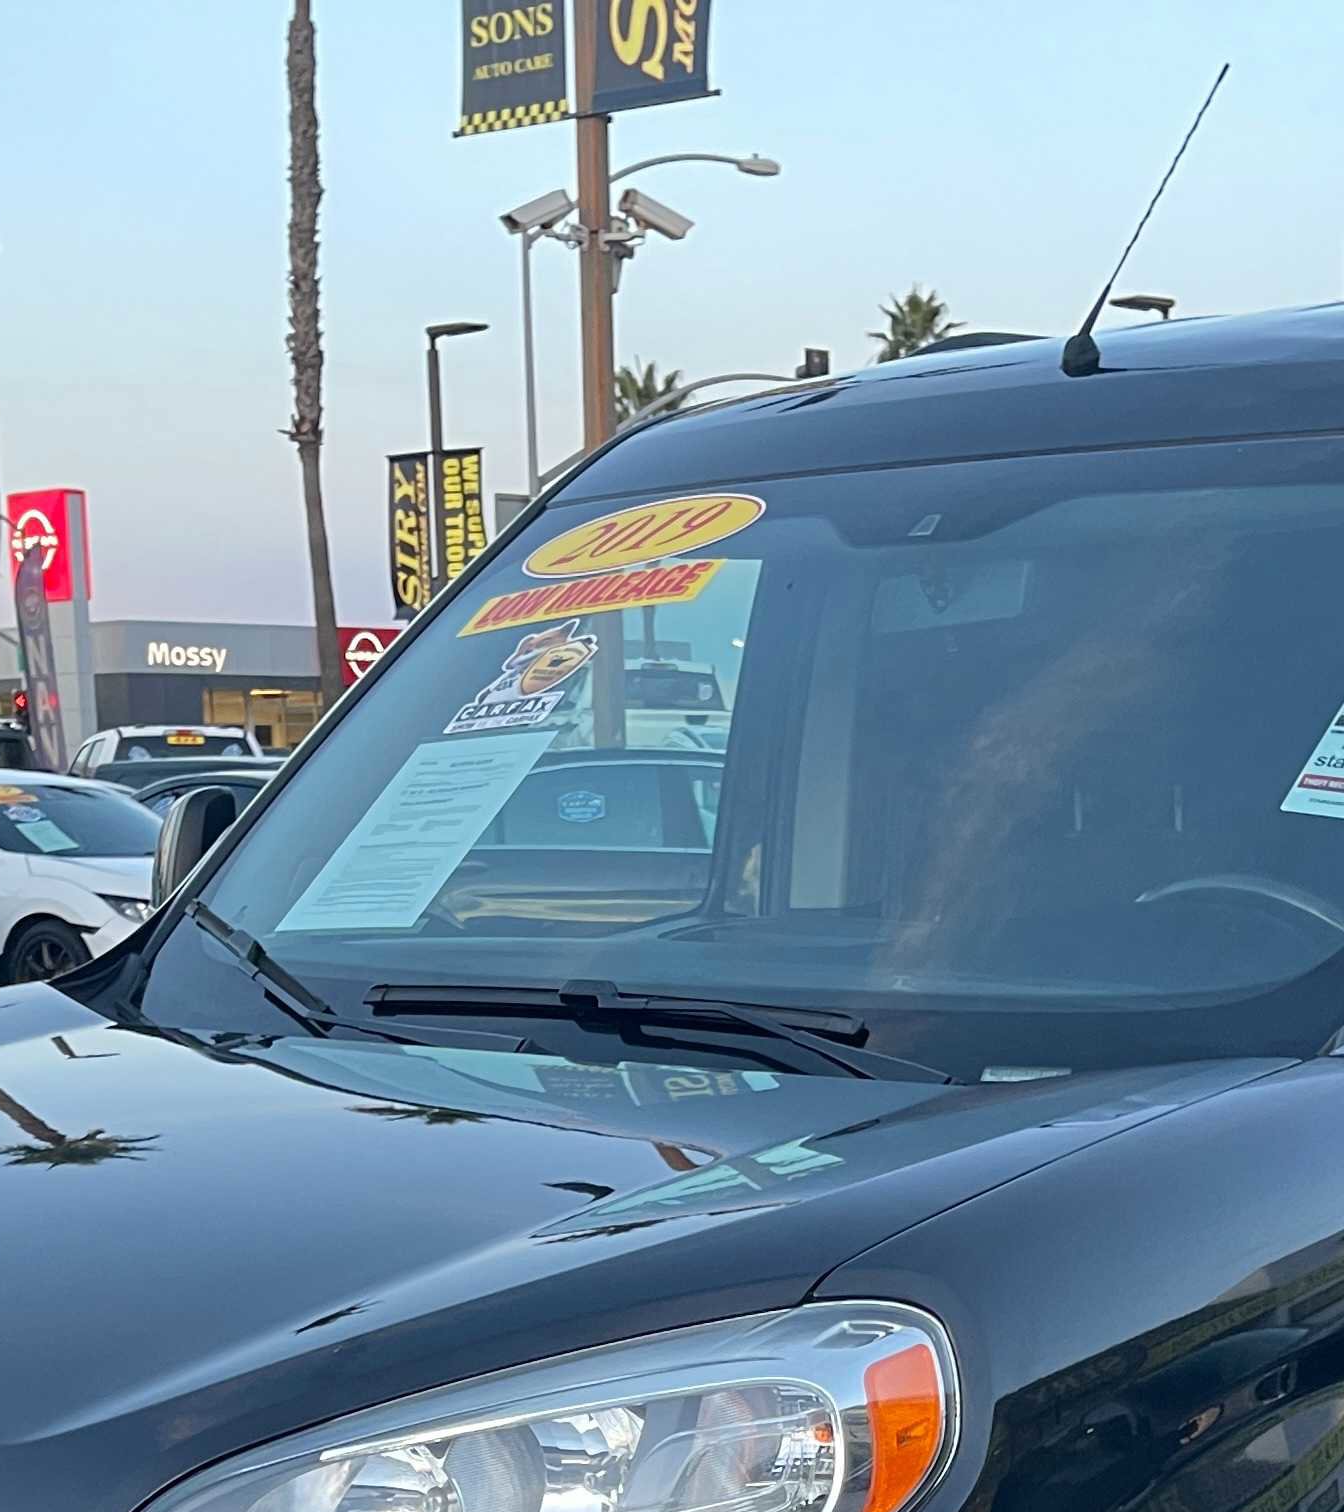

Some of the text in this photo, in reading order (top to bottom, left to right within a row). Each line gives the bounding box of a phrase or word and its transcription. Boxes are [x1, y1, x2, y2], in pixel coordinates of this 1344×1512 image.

[470, 3, 555, 48] SONS
[472, 53, 555, 81] AUTO CARE
[443, 458, 463, 509] OUR
[462, 455, 480, 494] WE
[394, 462, 423, 612] SIRY
[546, 501, 734, 568] 2019
[473, 561, 716, 630] LOW MILEAGE
[147, 641, 228, 673] Mossy
[459, 699, 552, 720] CARFAX
[1303, 776, 1328, 788] THEFT
